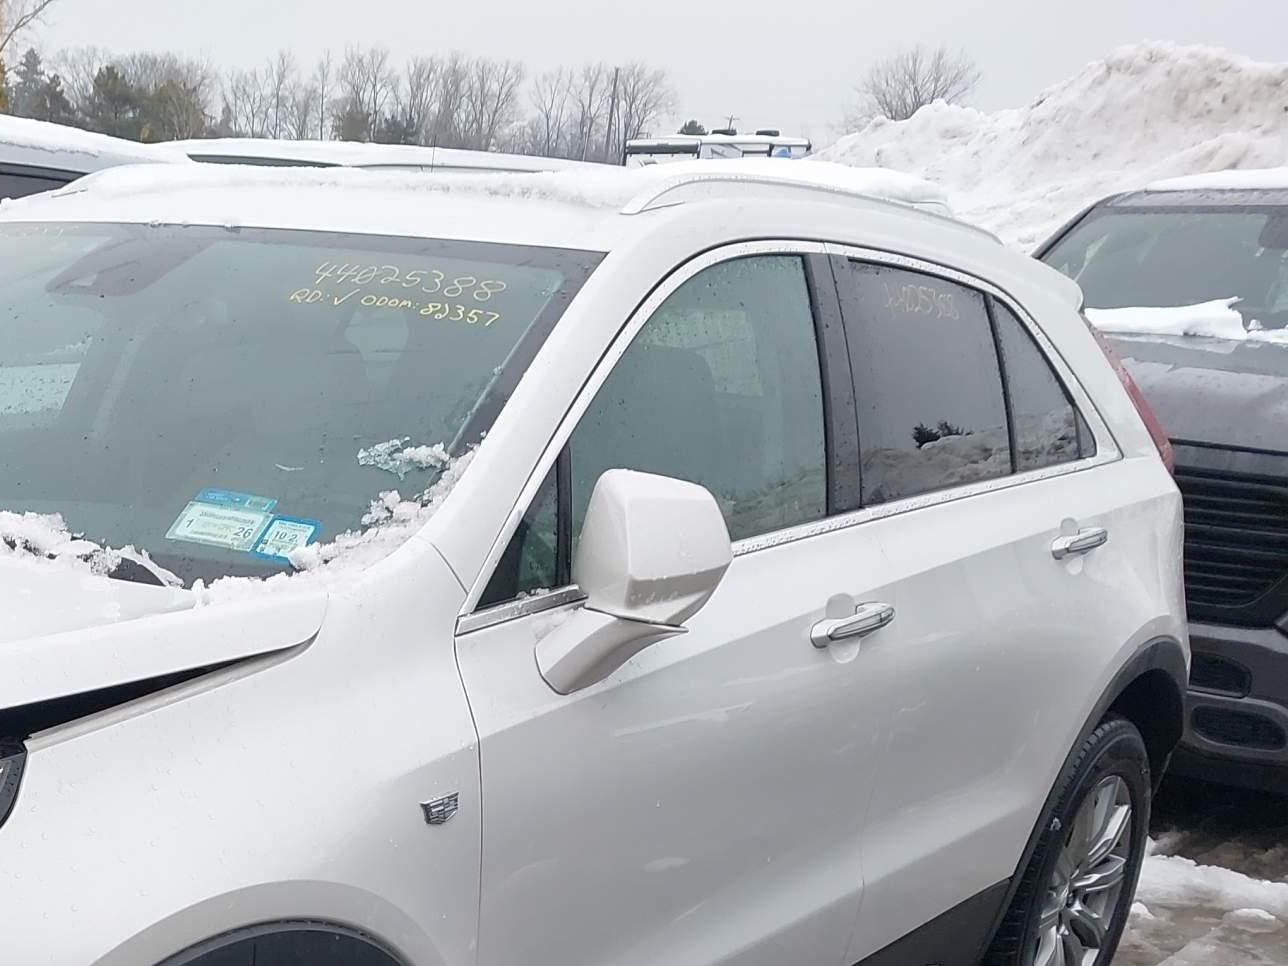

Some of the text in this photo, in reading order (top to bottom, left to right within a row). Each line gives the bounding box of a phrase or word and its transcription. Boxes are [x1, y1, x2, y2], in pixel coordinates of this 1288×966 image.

[315, 262, 506, 301] 44025388
[420, 303, 500, 326] 82357
[233, 526, 254, 539] 26
[274, 530, 288, 540] 10
